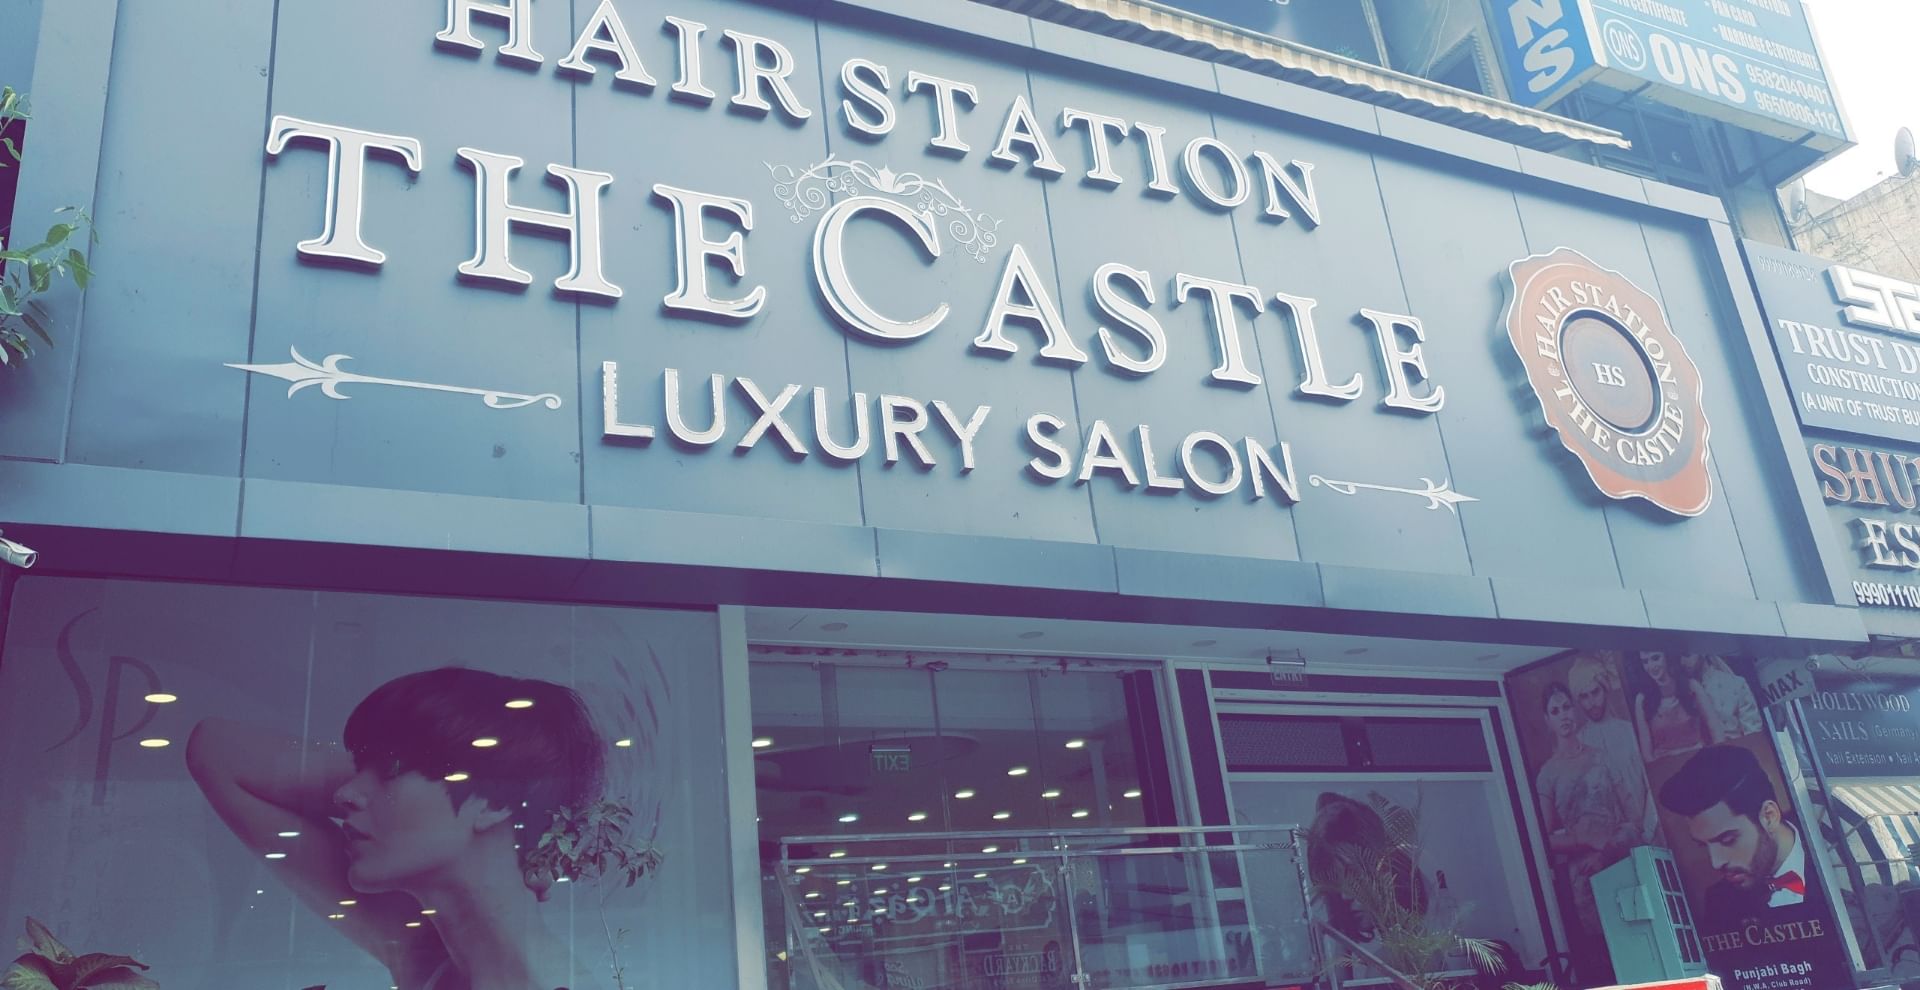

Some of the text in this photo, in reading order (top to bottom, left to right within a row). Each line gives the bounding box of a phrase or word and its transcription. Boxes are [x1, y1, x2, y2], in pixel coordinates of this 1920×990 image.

[1609, 27, 1640, 62] ONS
[1649, 33, 1746, 104] ONS
[1745, 63, 1833, 107] 9582040401
[435, 0, 1320, 228] HAIR STATION
[266, 115, 1445, 413] THE CASTLE
[1536, 280, 1677, 386] HAIR STATION
[1777, 319, 1920, 374] TRUST D
[1592, 362, 1626, 388] HS
[602, 361, 1300, 503] LUXURY SALON
[1552, 378, 1684, 467] THE CASTLE
[1818, 396, 1845, 414] UNIT
[1847, 399, 1863, 416] OF
[1863, 402, 1902, 424] TRUST
[1858, 517, 1920, 569] ES
[1809, 690, 1911, 713] HOLLYWOOD
[1818, 720, 1869, 741] NAILS
[1845, 751, 1886, 766] Extension
[1703, 919, 1824, 953] THE CASTLE
[1734, 961, 1812, 981] Punjabi Bagh
